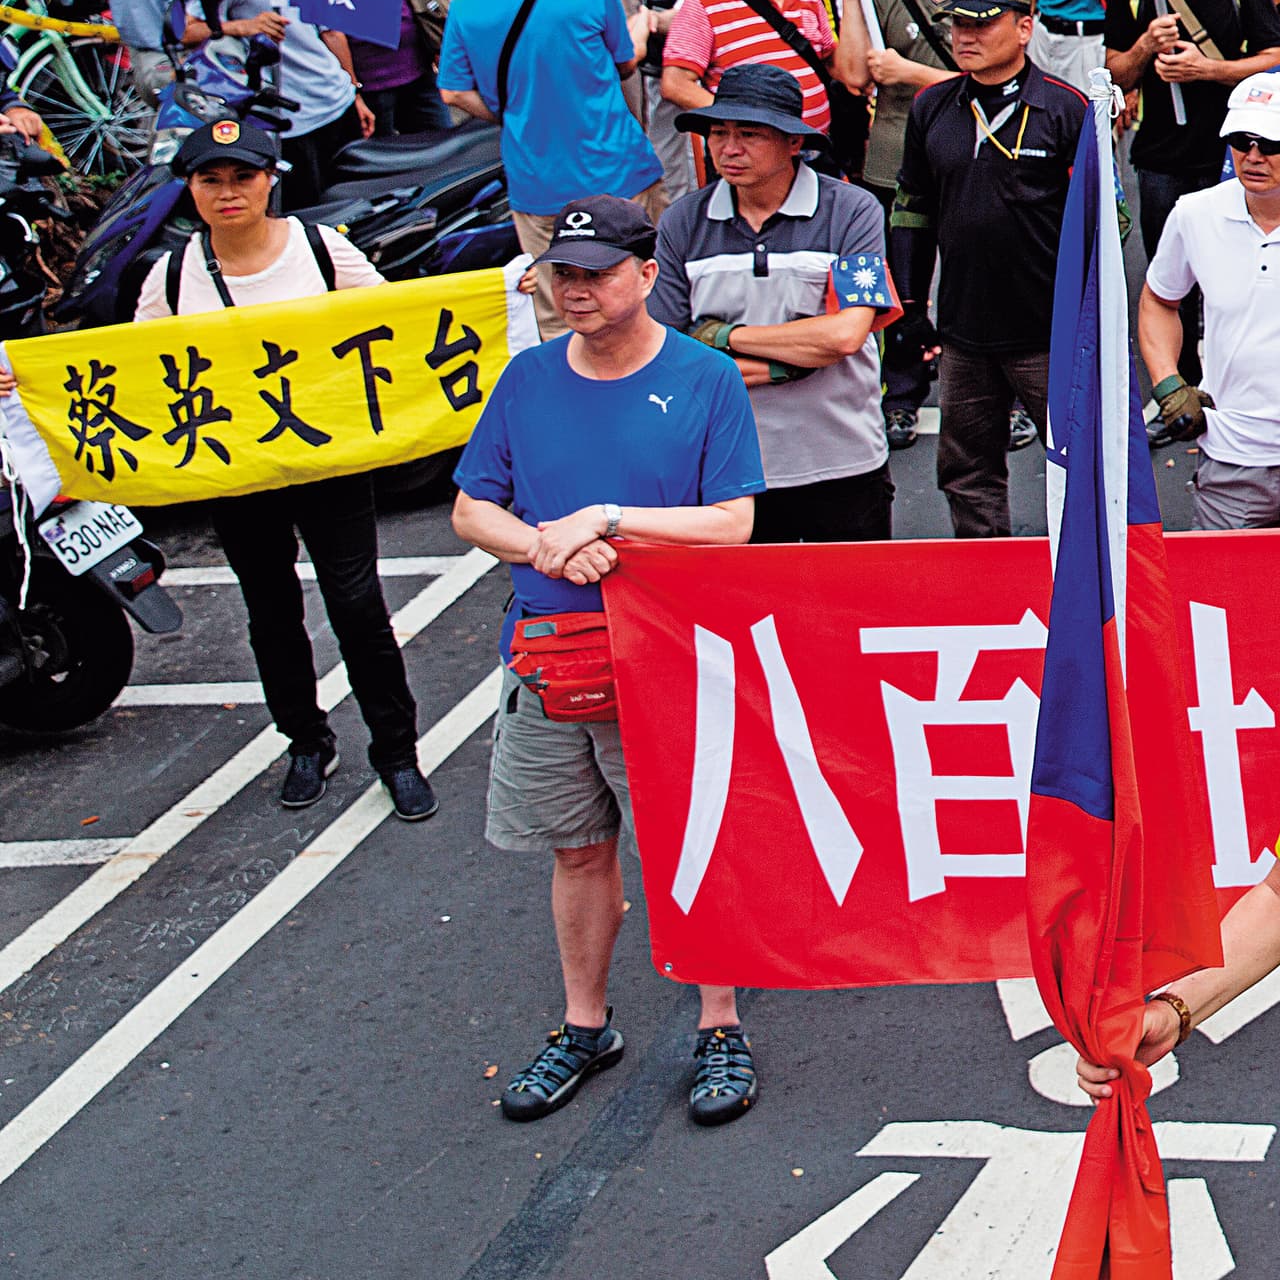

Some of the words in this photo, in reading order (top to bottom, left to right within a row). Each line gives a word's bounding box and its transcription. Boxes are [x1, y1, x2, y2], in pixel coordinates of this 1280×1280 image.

[62, 307, 484, 482] 蔡英文下台
